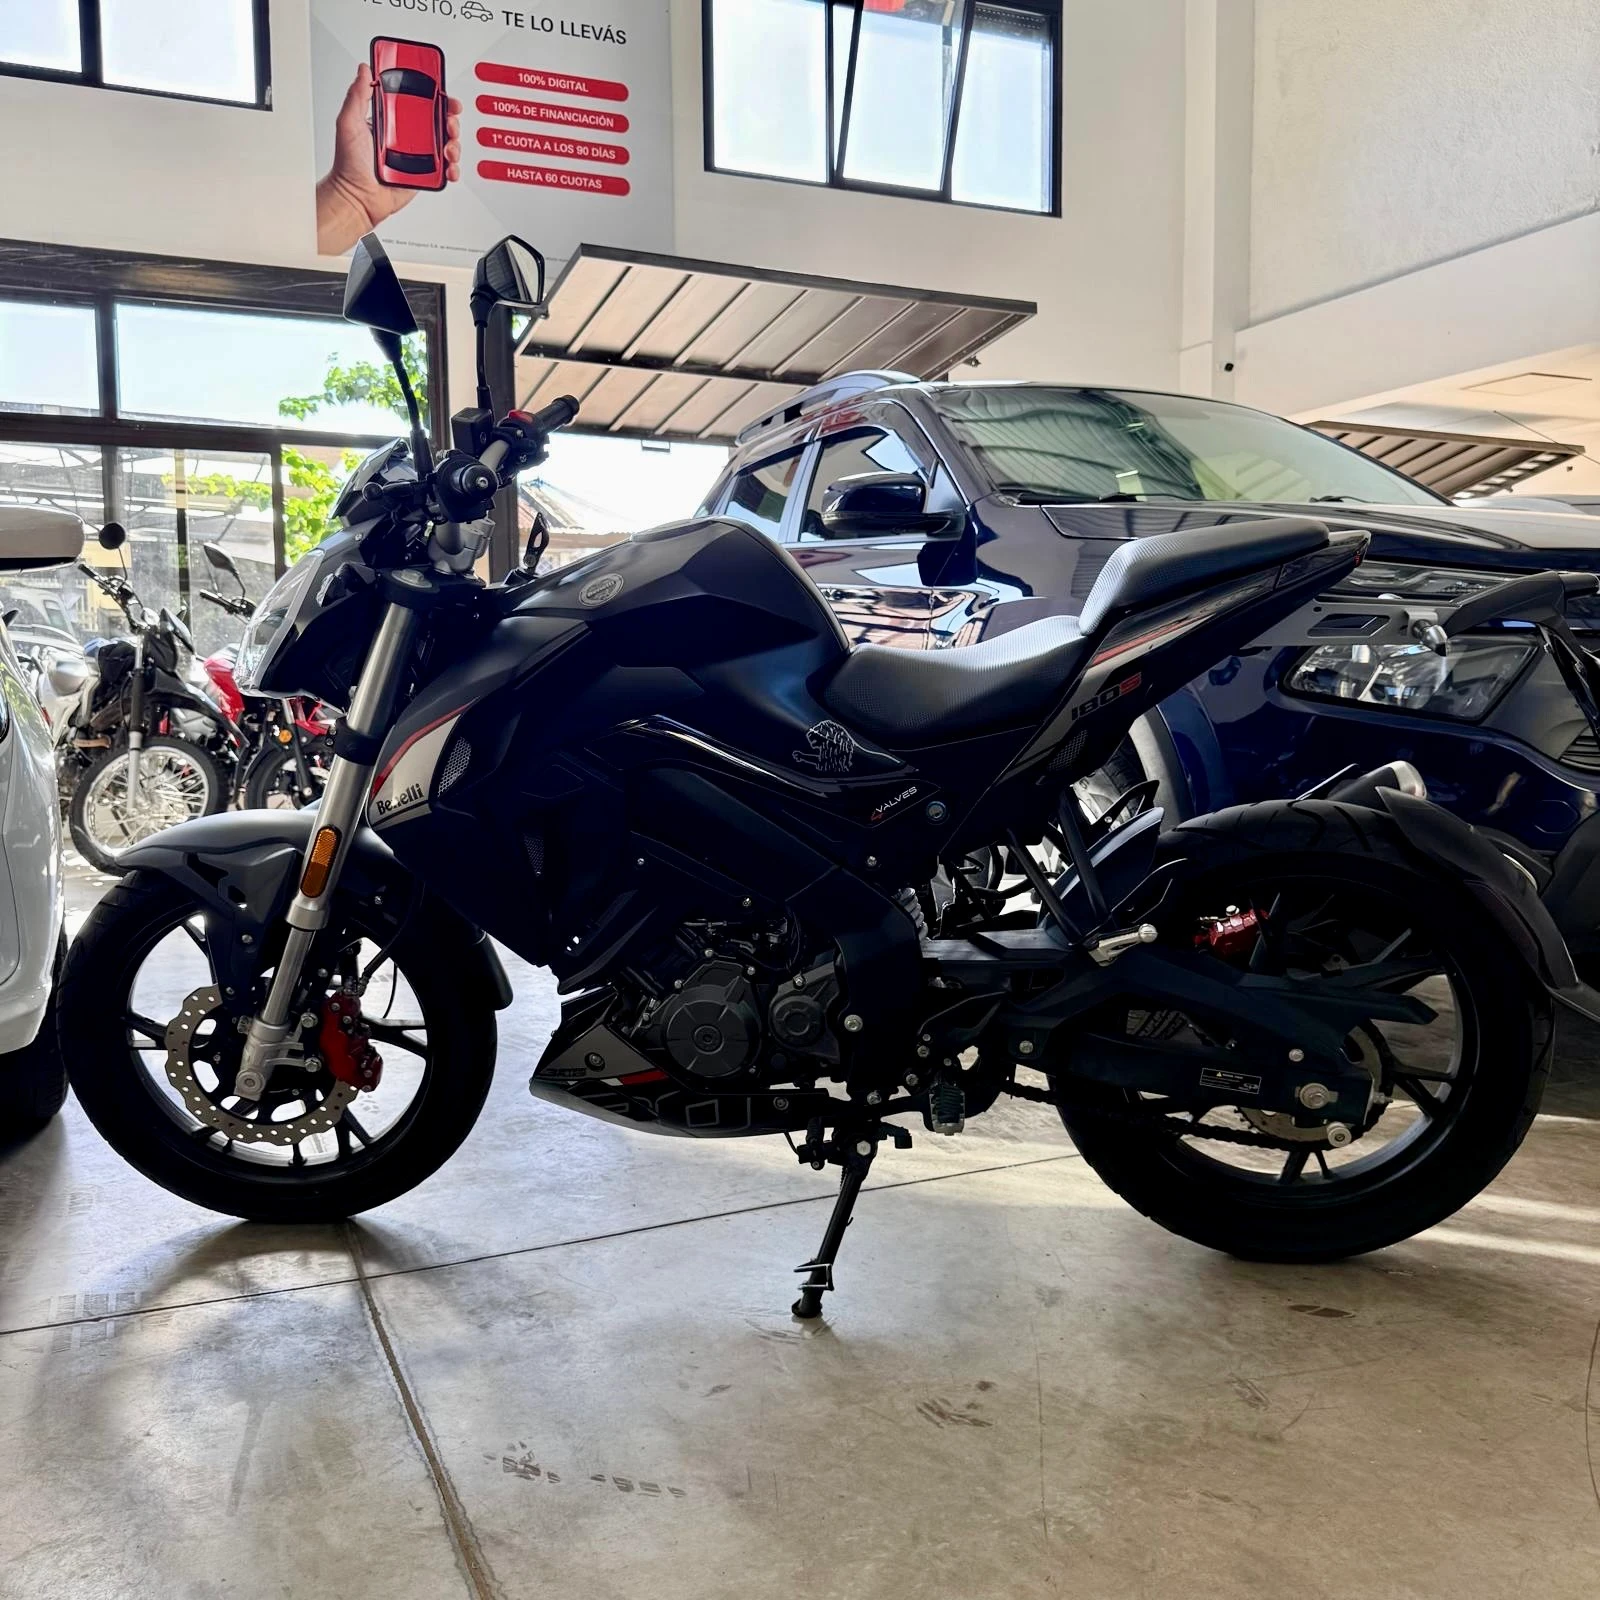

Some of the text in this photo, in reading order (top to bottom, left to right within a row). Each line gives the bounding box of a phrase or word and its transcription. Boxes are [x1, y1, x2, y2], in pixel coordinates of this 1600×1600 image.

[501, 10, 525, 28] TE
[531, 15, 554, 32] LO
[560, 20, 627, 45] LLEVÁS
[518, 72, 589, 93] 100% DIGITAL
[492, 101, 615, 128] 100% DE FINANCIACIÓN
[504, 135, 541, 150] CUOTA
[543, 142, 552, 151] A
[553, 143, 574, 154] LOS
[576, 145, 589, 156] 90
[591, 146, 616, 160] DÍAS
[507, 167, 602, 189] HASTA 60 CUOTAS
